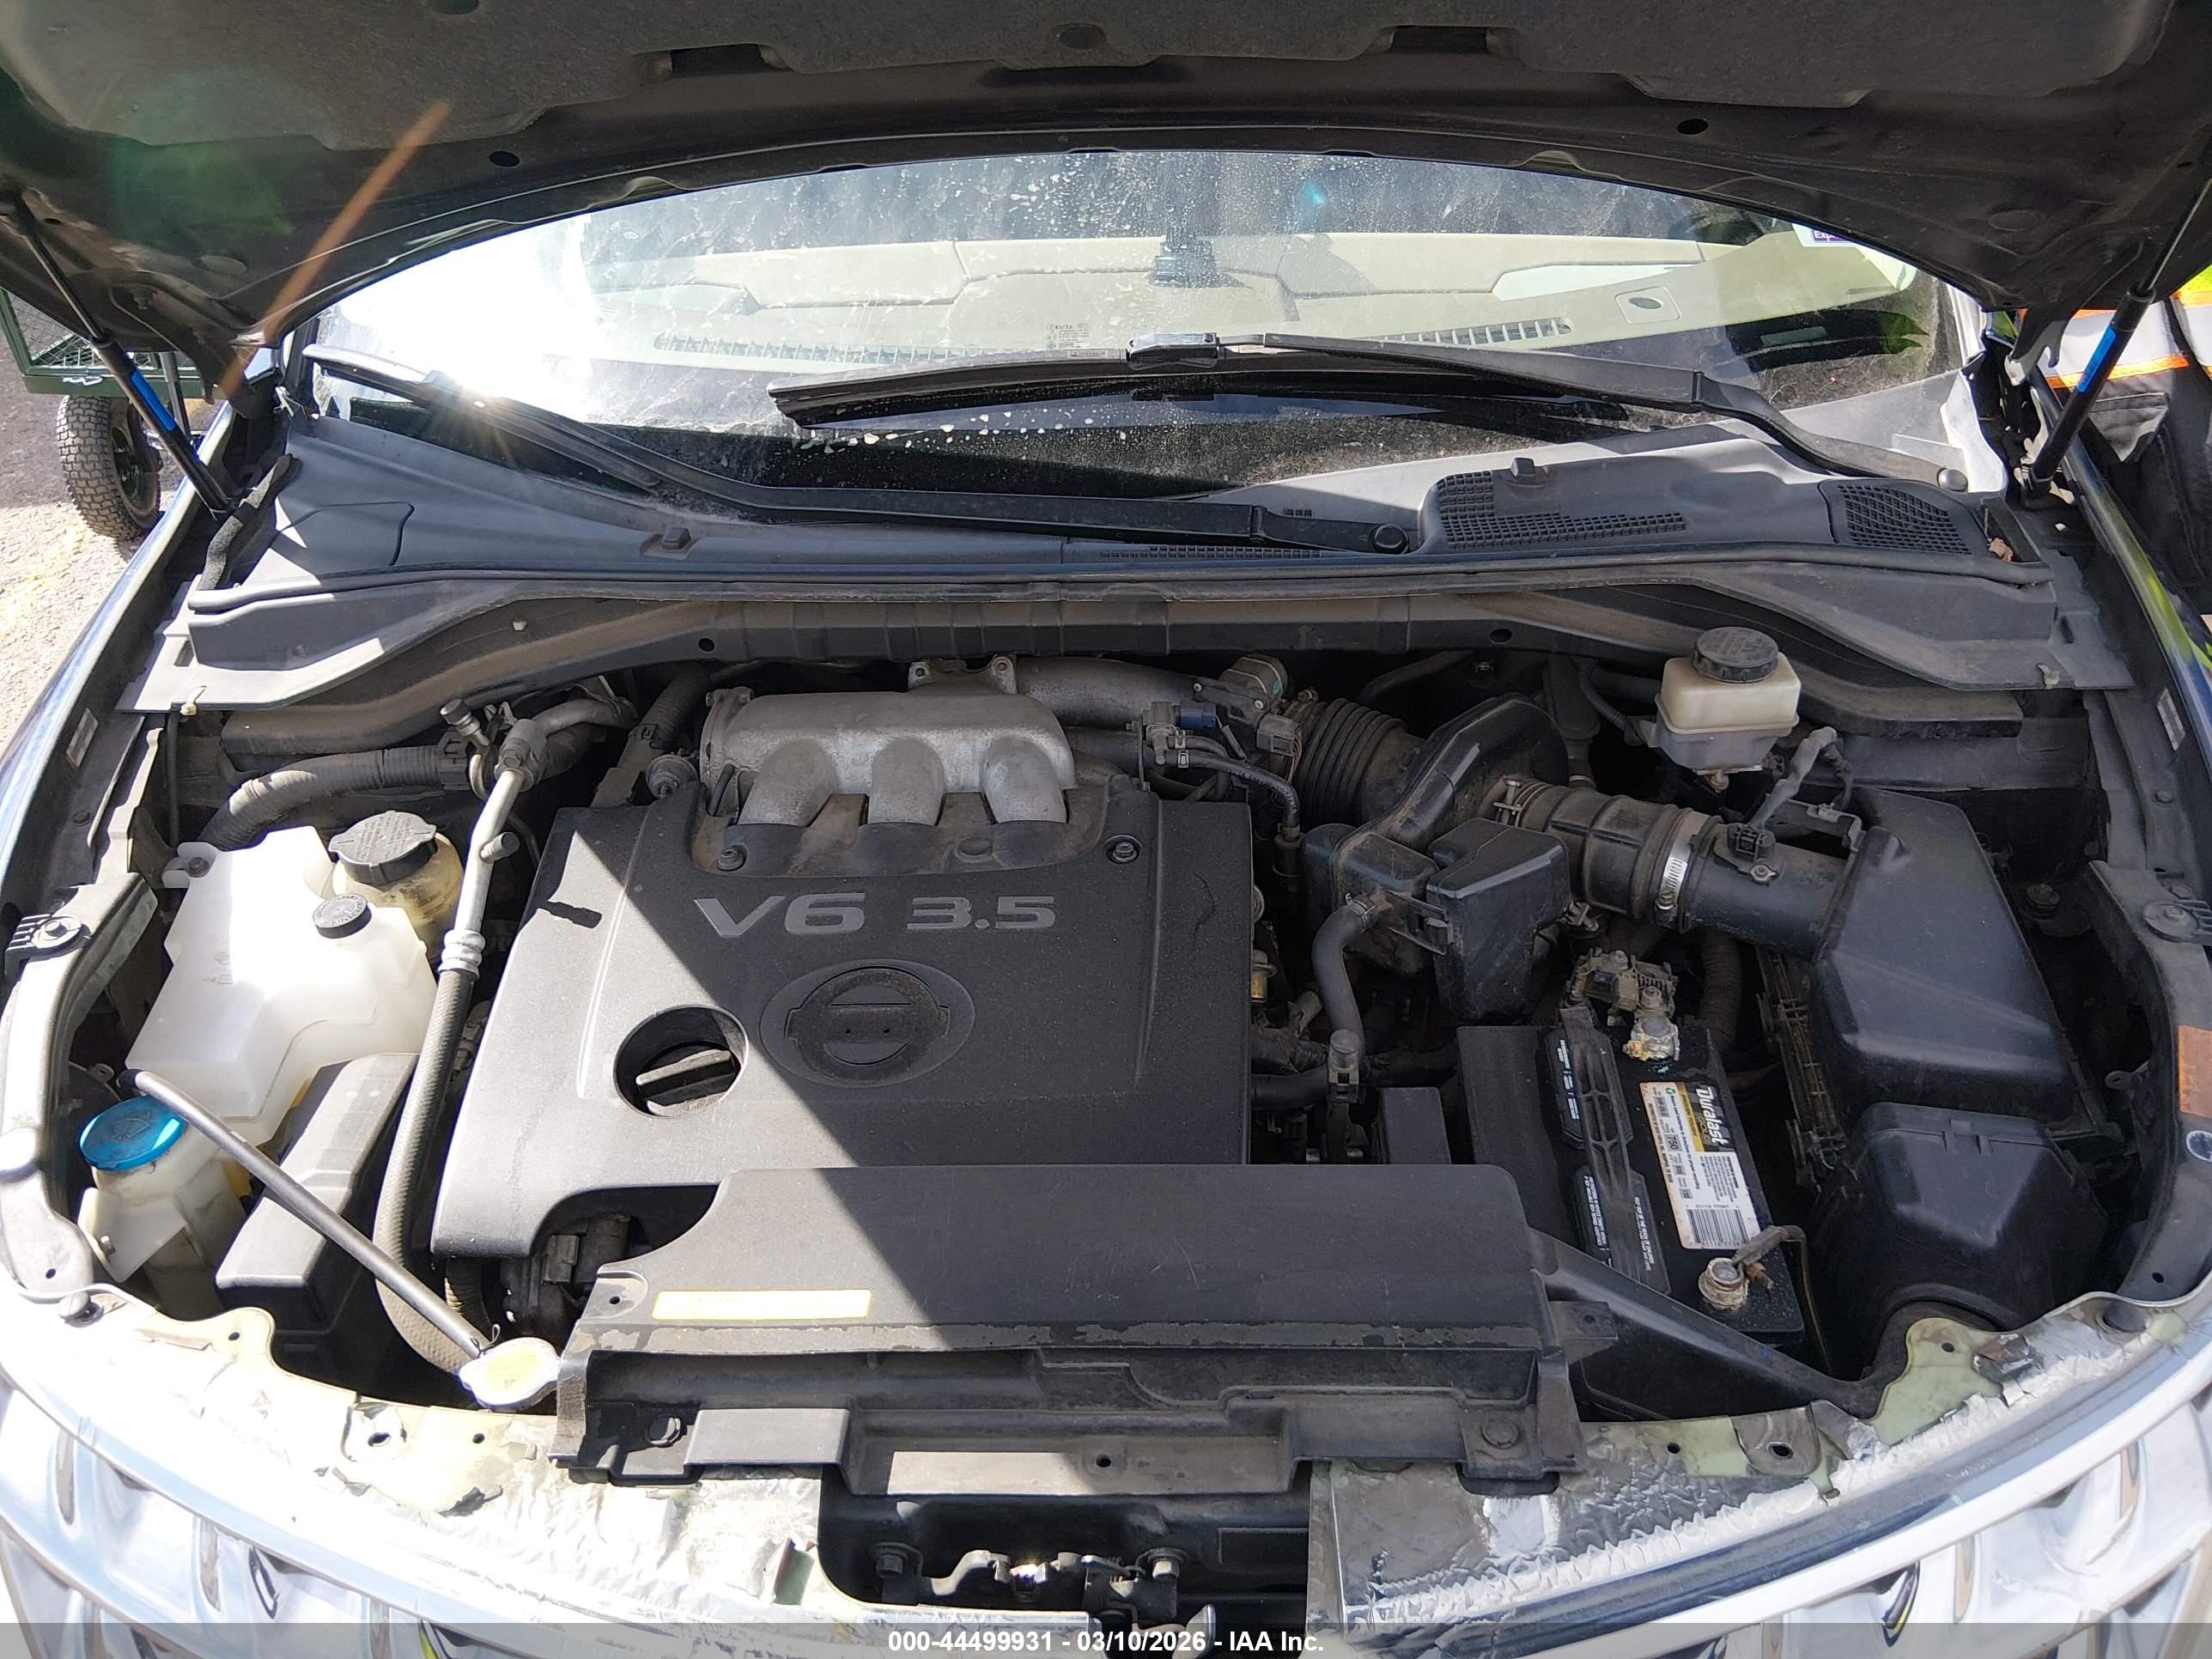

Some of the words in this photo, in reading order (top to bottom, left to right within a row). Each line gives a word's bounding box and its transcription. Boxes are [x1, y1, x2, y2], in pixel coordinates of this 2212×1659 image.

[693, 893, 866, 937] V6
[906, 896, 1055, 932] 3.5
[1695, 1086, 1729, 1144] Duralast
[1666, 1136, 1679, 1149] 750
